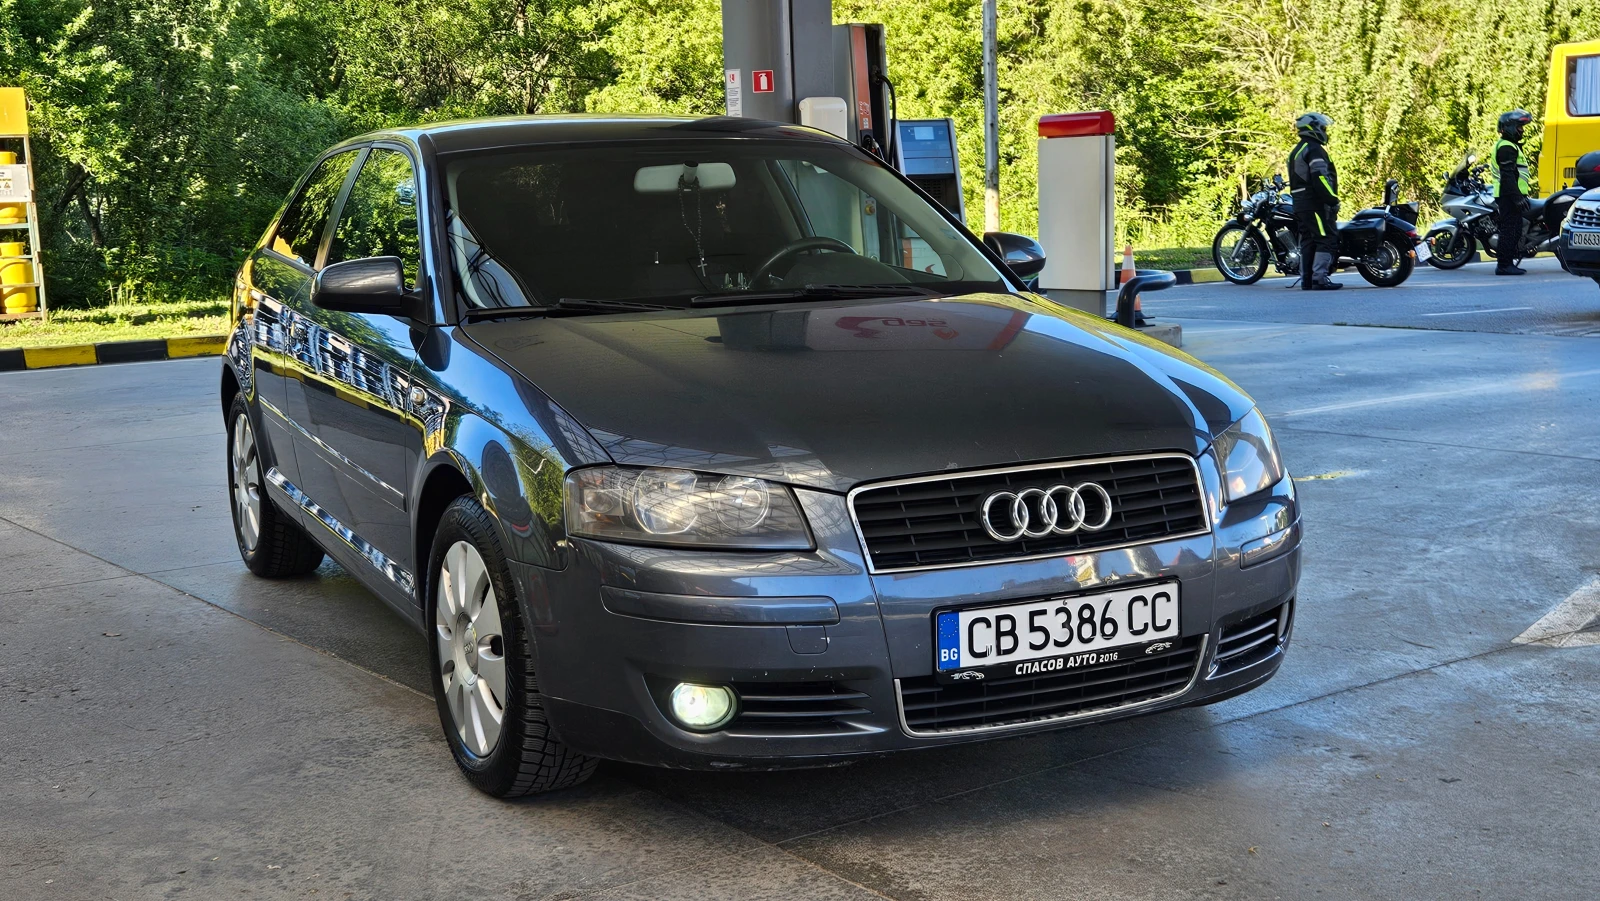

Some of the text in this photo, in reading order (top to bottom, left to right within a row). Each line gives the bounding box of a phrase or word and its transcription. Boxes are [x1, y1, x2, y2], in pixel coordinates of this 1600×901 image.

[967, 591, 1172, 659] CB 5386 CC
[941, 648, 958, 661] BG
[1015, 652, 1118, 675] СПАСОВ АУТО 2016
